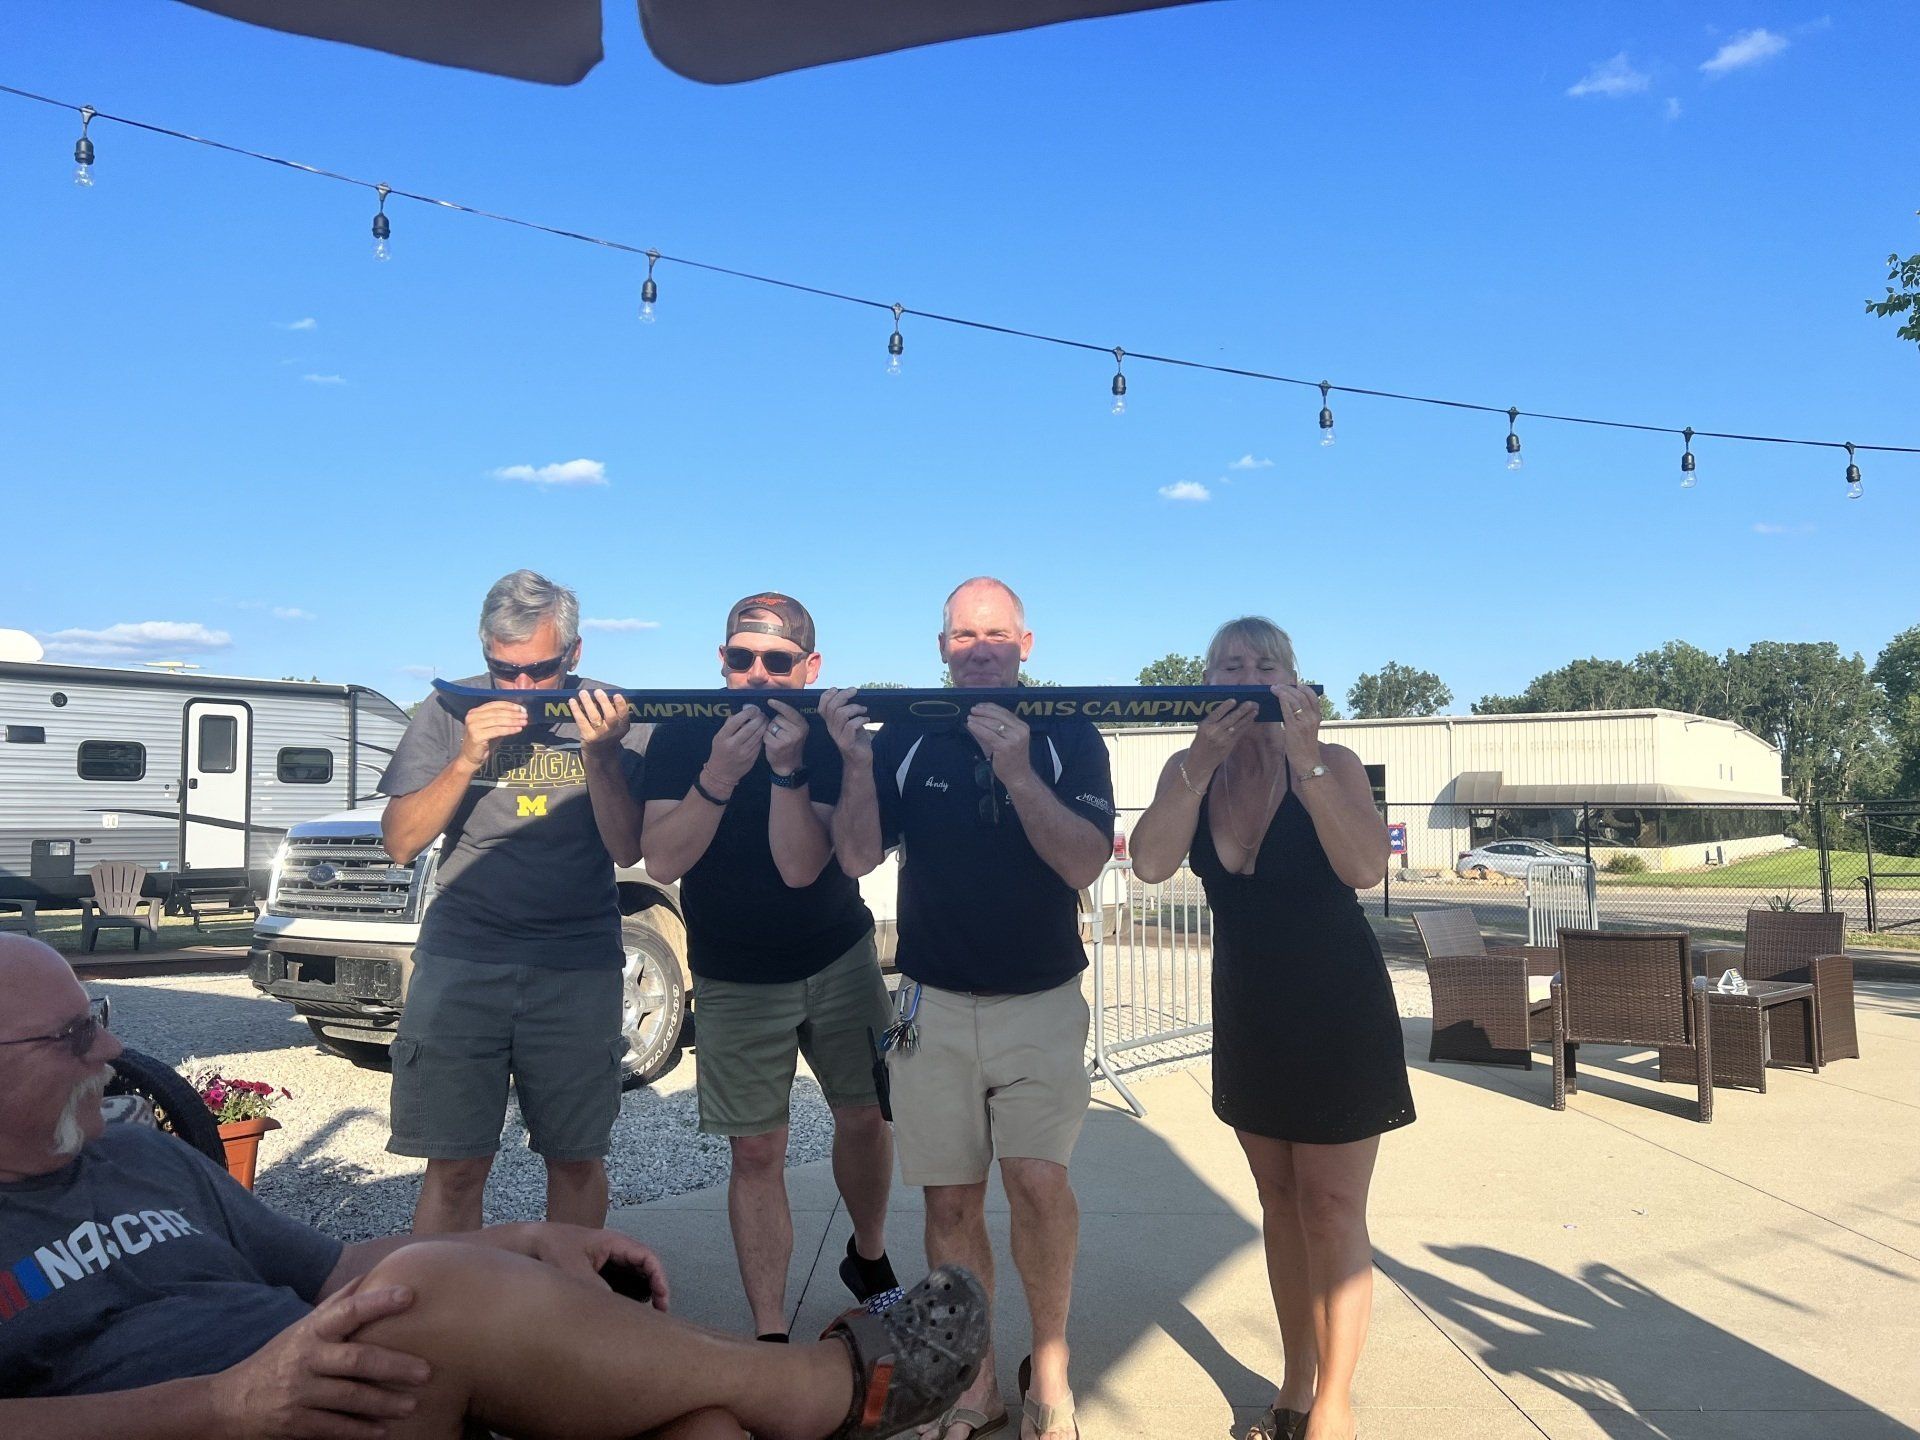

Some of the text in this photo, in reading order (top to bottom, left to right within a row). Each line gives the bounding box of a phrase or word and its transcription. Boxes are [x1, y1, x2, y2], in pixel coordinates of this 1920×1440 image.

[612, 703, 732, 717] AMPING
[1015, 701, 1077, 716] MIS
[472, 751, 585, 780] ICHIGA
[925, 776, 948, 792] Andy
[516, 795, 548, 816] M
